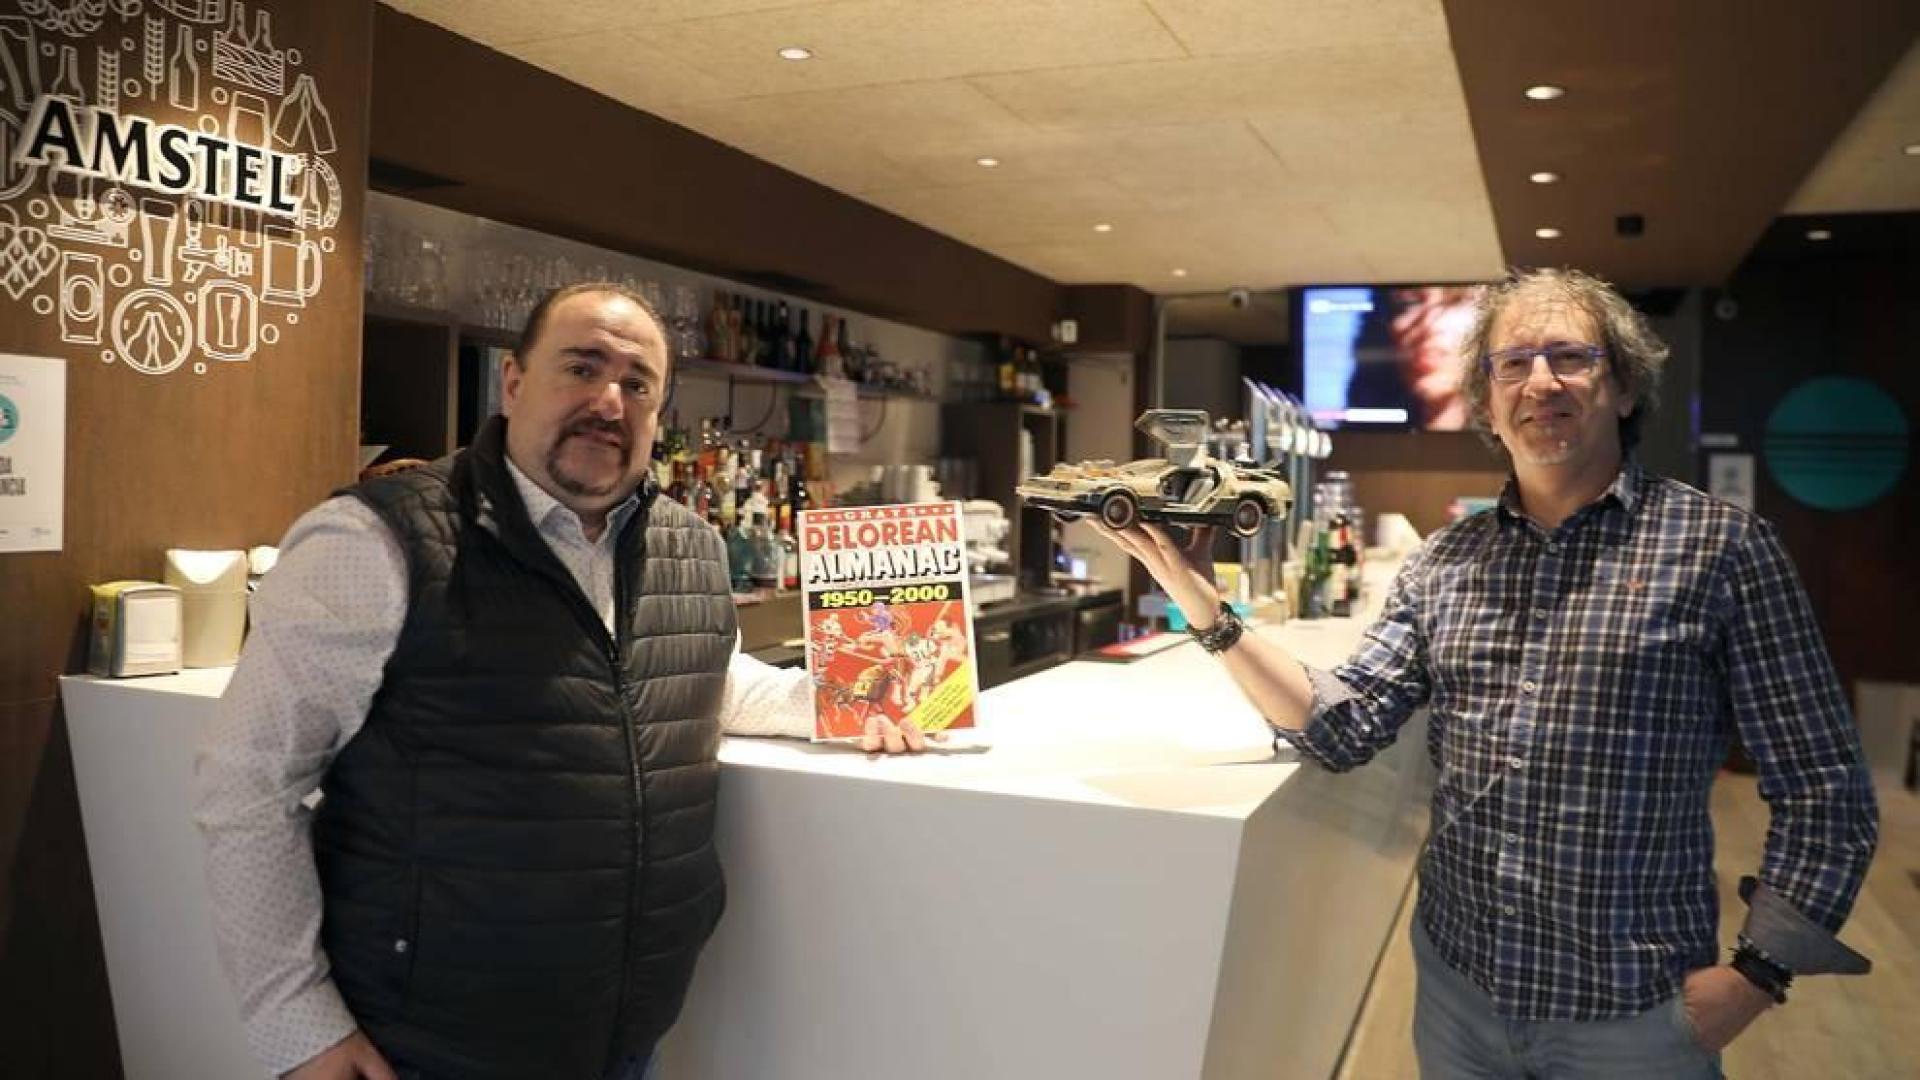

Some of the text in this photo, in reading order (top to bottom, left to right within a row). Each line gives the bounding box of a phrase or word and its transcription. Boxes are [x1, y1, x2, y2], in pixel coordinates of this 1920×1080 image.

[24, 97, 297, 213] AMSTEL
[806, 517, 958, 551] DELOREAN
[807, 546, 962, 584] ALMANAC
